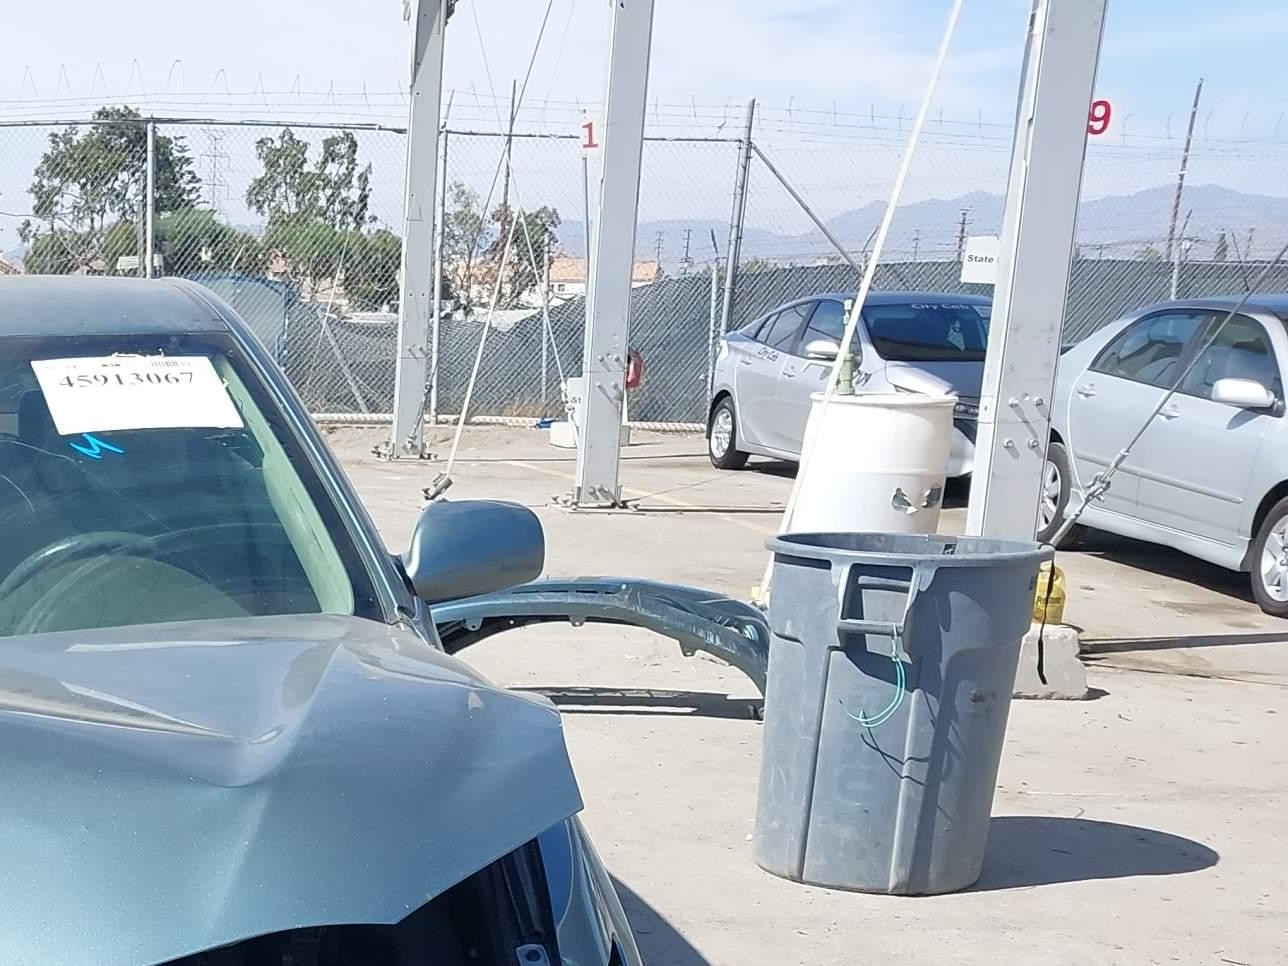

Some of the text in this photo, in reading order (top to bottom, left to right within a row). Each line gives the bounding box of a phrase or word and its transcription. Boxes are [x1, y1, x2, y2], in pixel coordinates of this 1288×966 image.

[1087, 100, 1111, 135] 9
[582, 121, 600, 149] 1
[967, 254, 994, 263] State
[59, 371, 193, 388] 45913067
